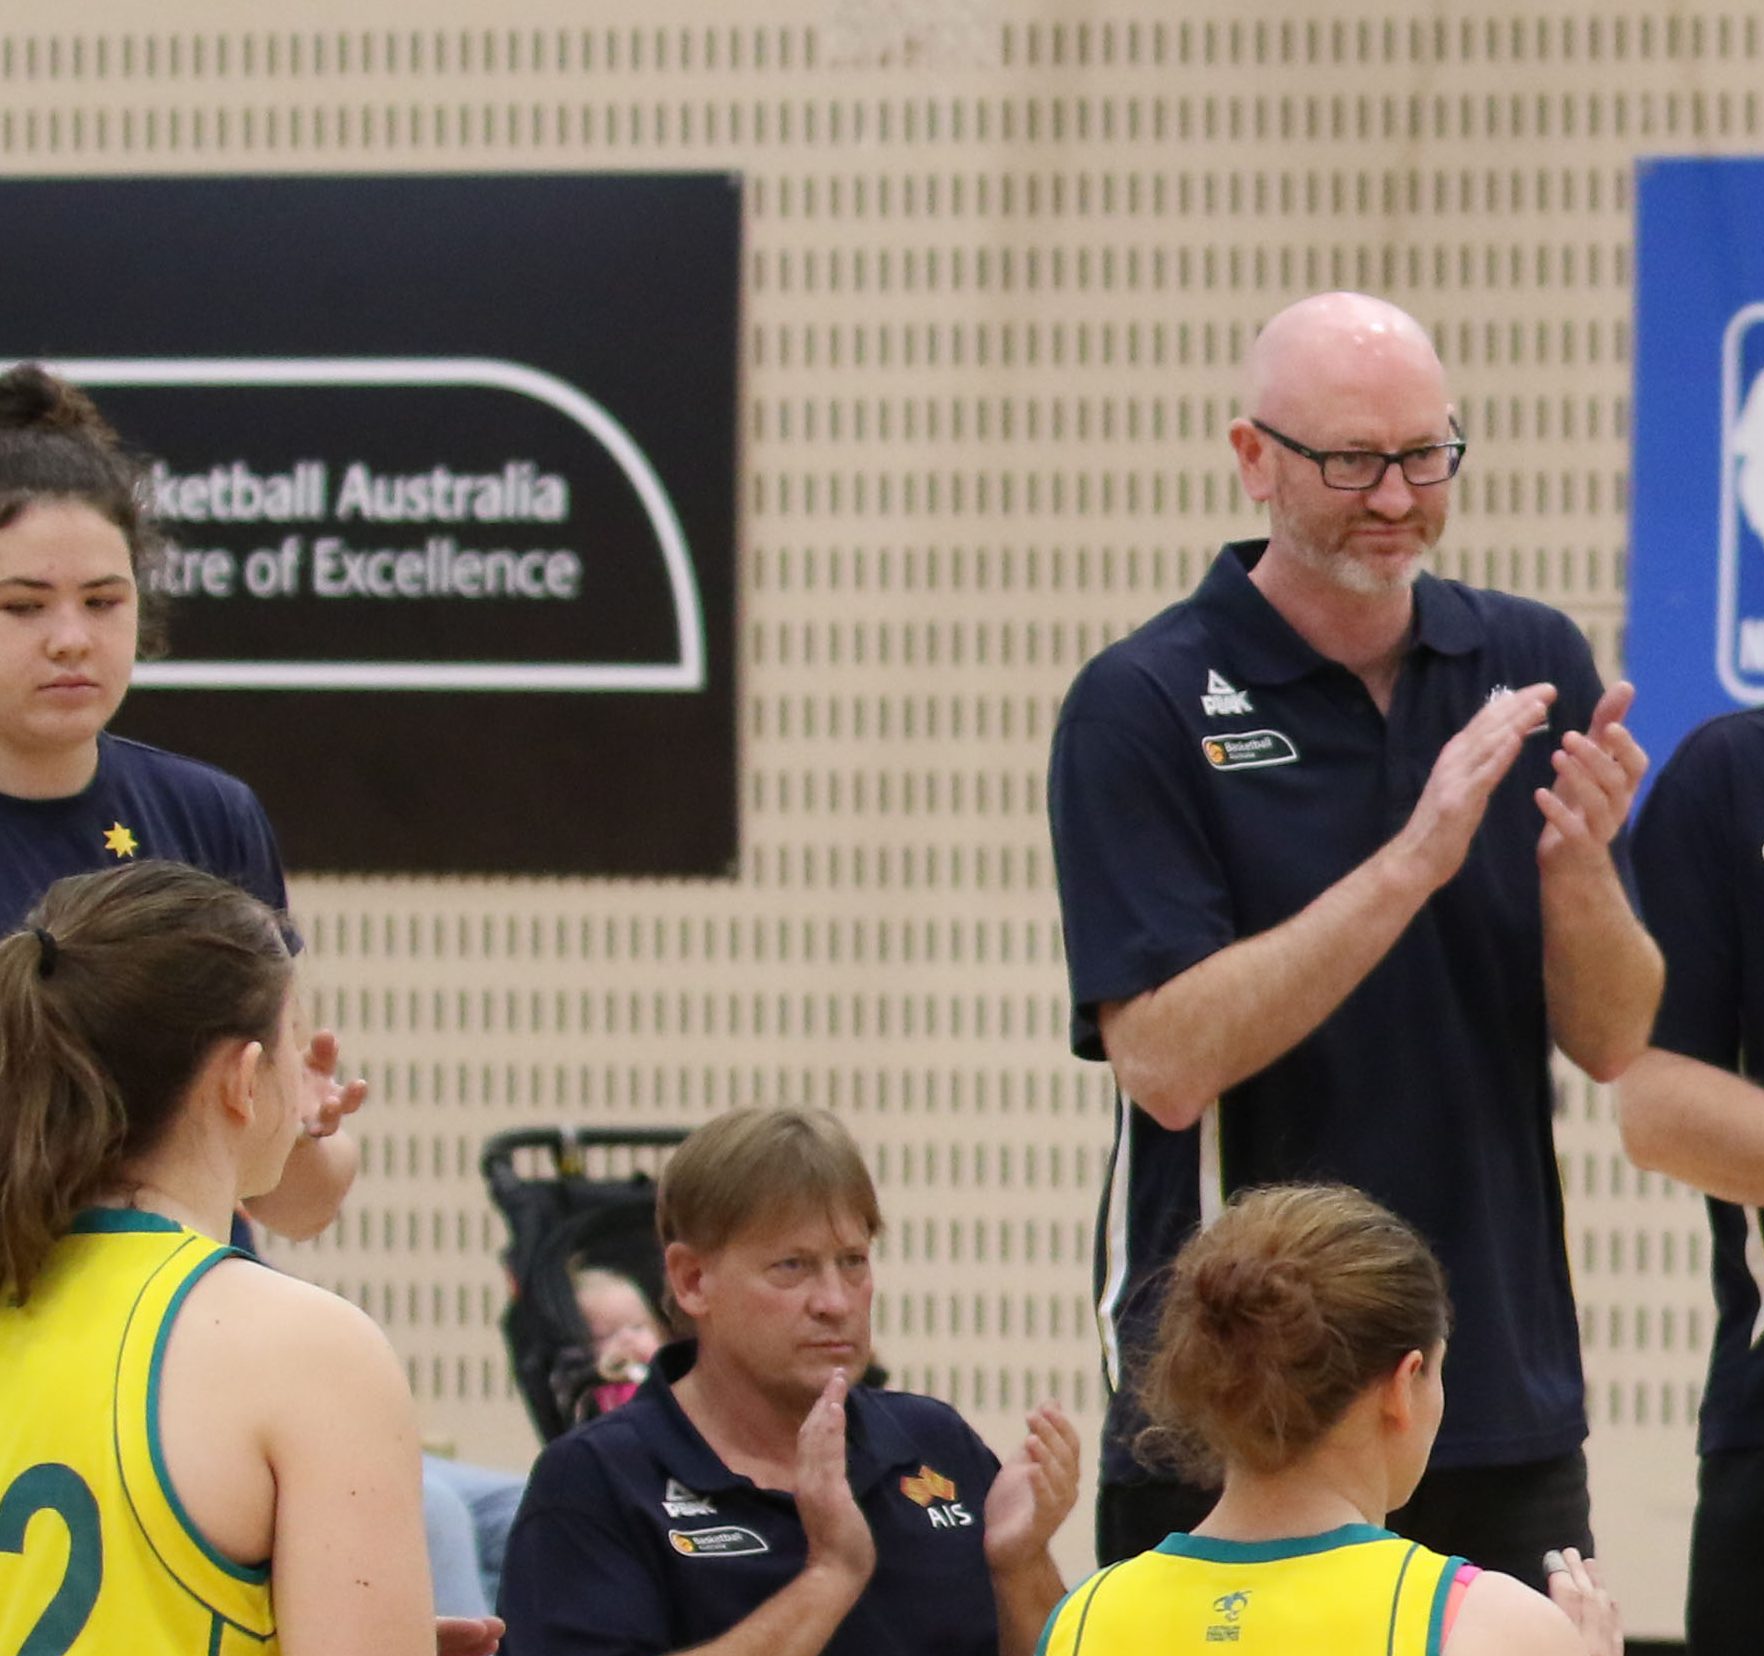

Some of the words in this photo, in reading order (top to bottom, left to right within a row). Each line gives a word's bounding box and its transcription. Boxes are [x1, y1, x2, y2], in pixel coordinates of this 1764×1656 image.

[153, 460, 326, 520] ketball
[337, 460, 569, 521] Australia
[151, 540, 234, 595] tre
[244, 536, 301, 596] of
[313, 537, 582, 597] Excellence
[928, 1505, 972, 1529] AIS
